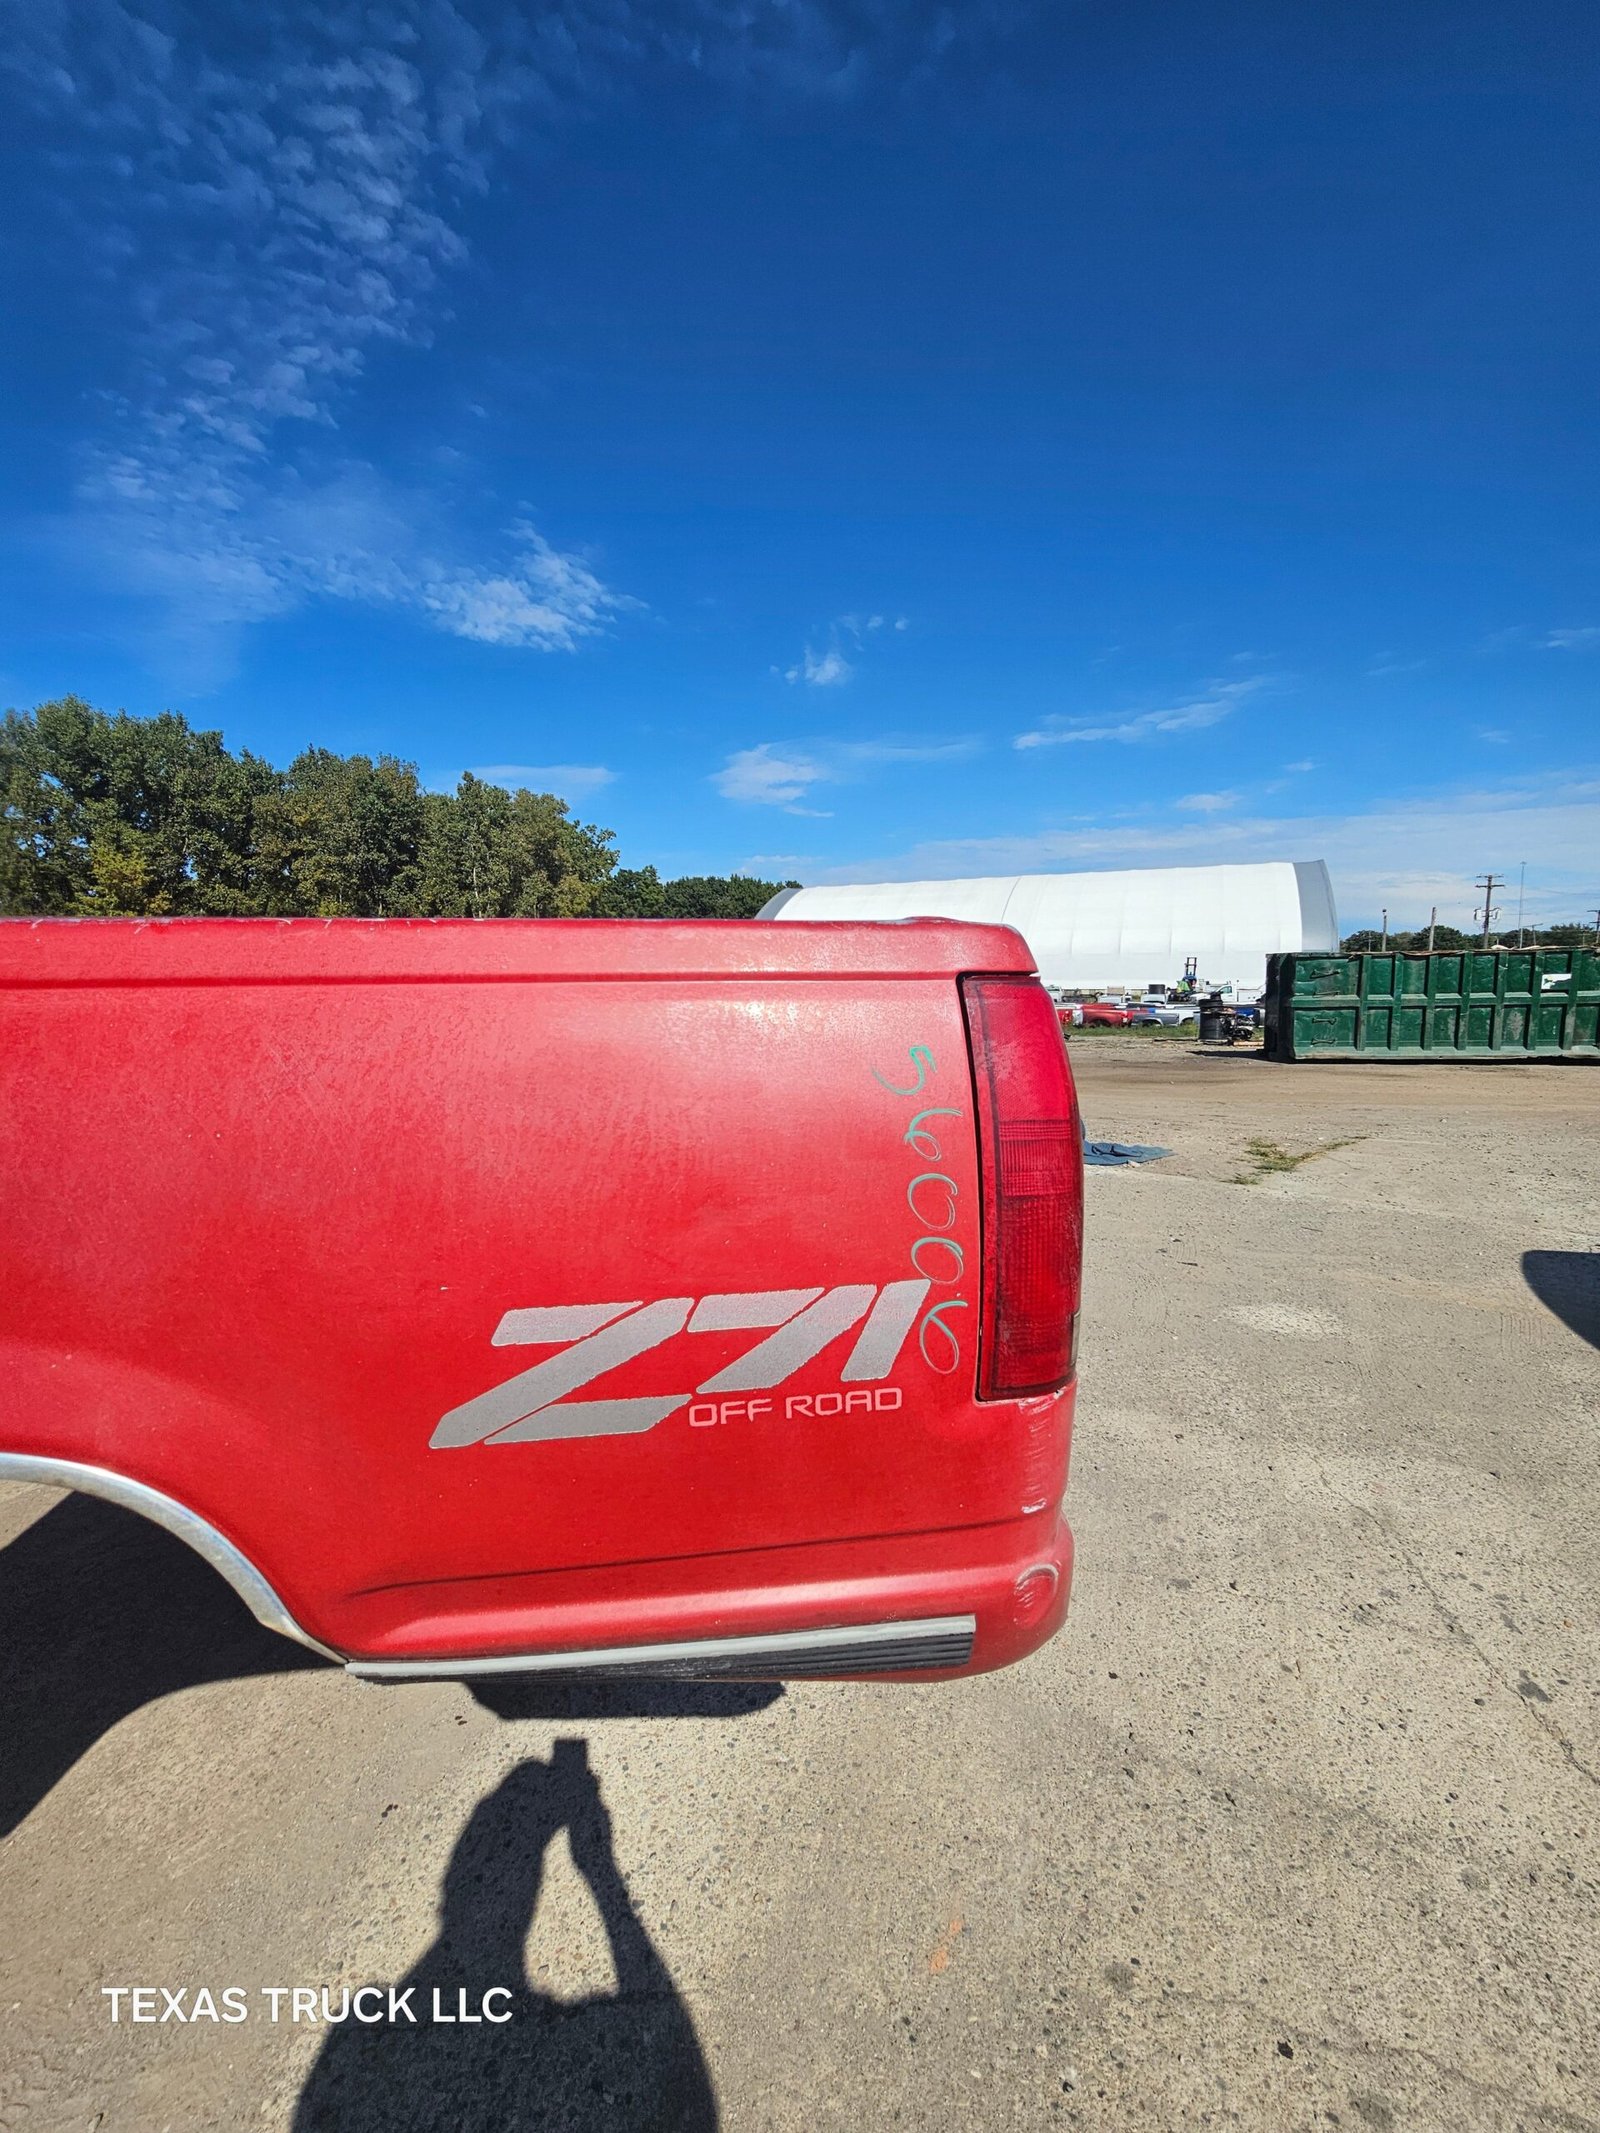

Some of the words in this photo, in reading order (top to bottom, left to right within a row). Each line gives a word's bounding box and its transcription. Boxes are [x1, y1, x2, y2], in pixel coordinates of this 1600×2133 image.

[429, 1279, 932, 1449] Z71
[688, 1398, 773, 1427] OFF
[785, 1387, 903, 1419] ROAD
